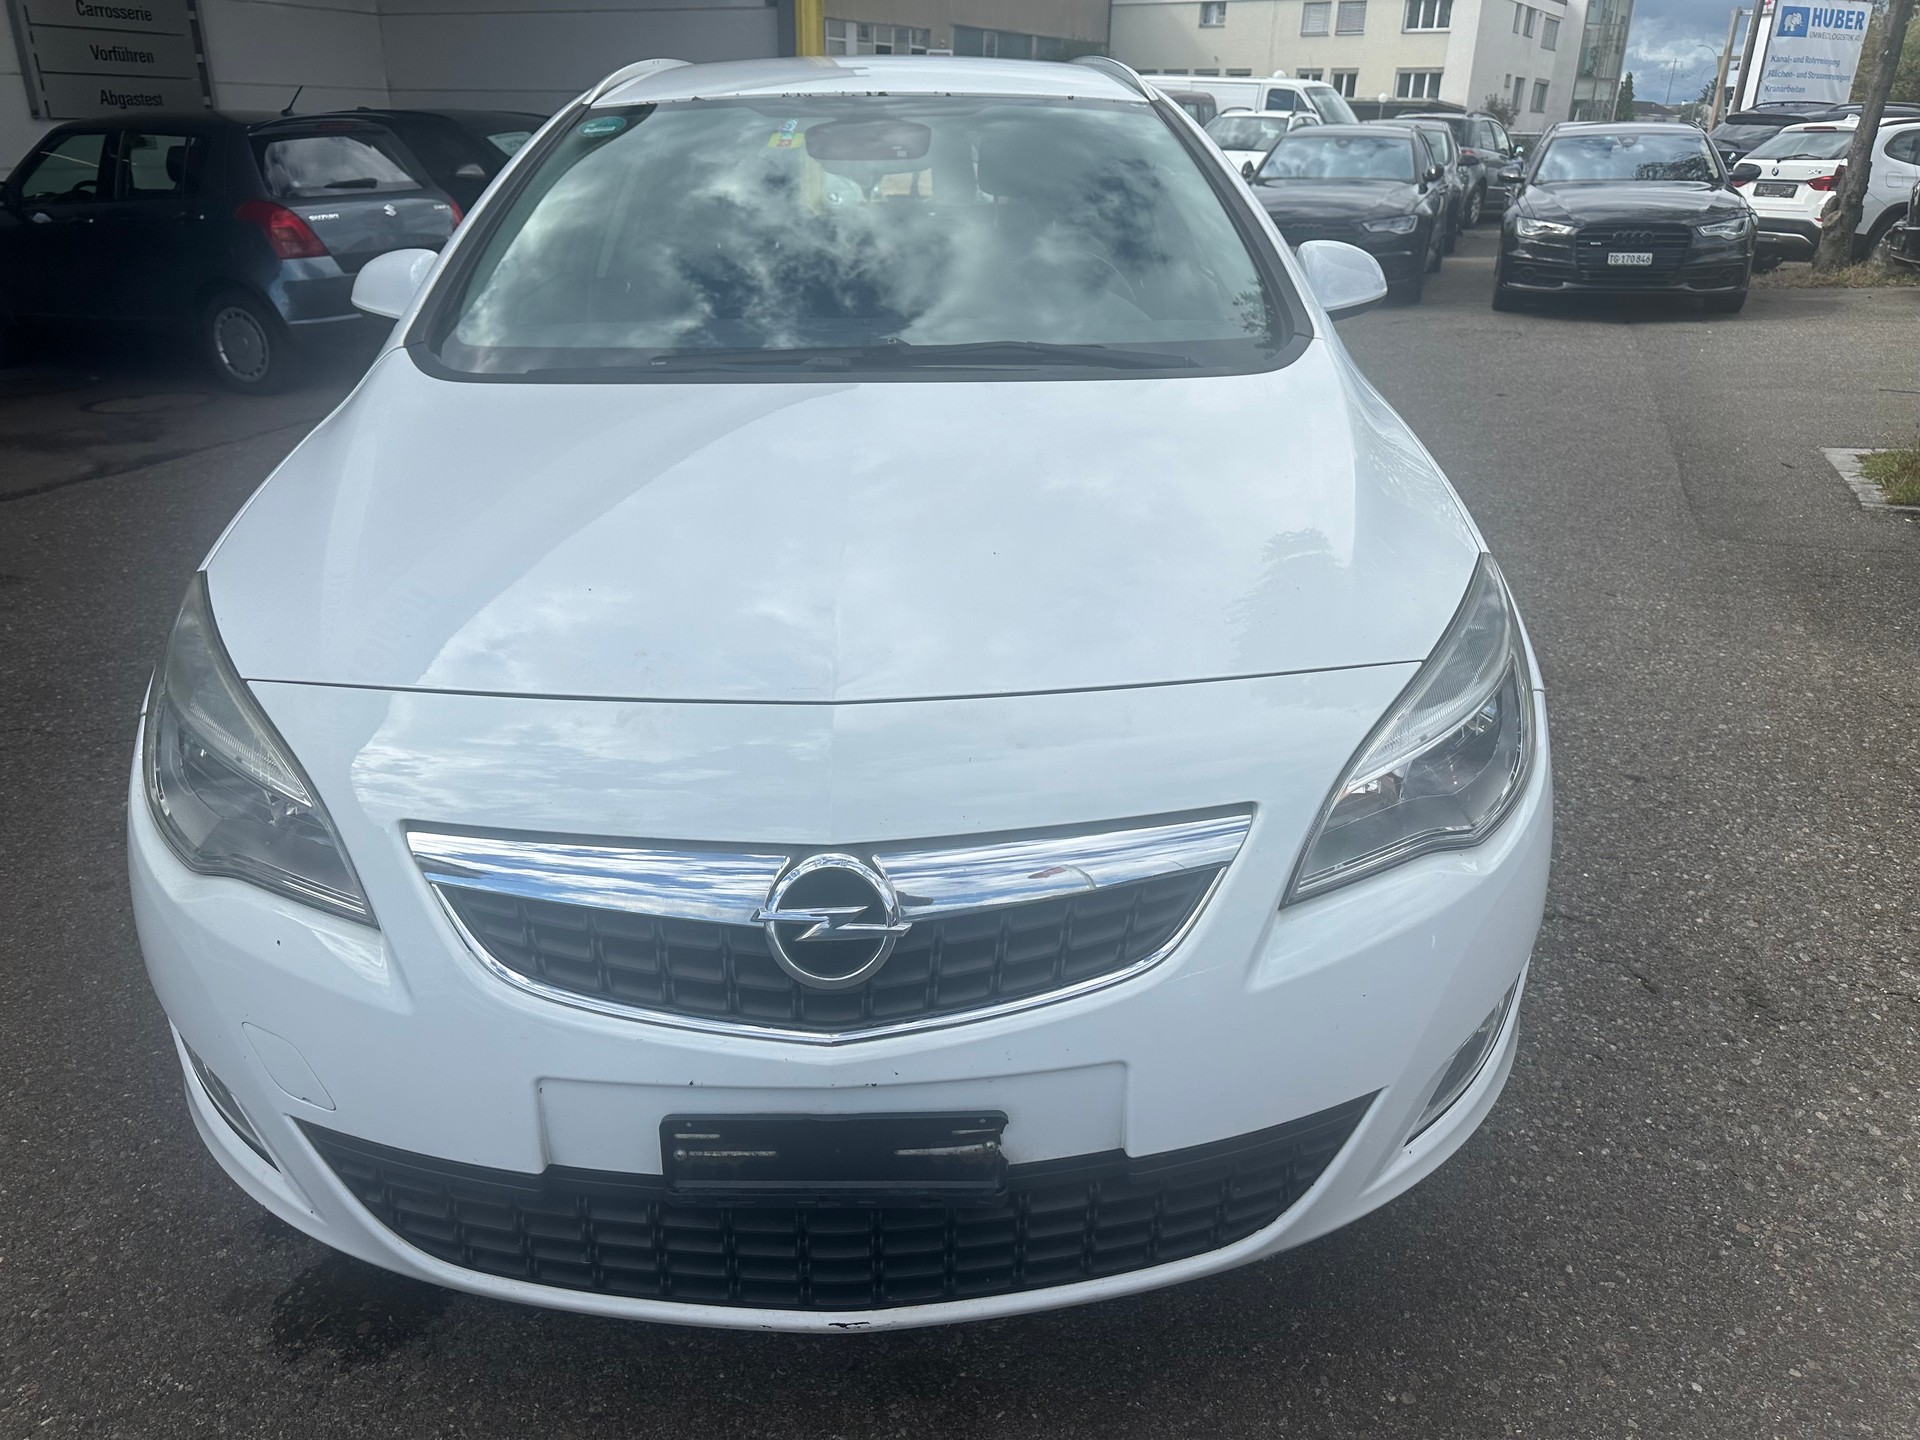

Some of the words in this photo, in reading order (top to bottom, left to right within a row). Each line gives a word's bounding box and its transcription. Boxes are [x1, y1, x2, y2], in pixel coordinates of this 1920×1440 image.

[75, 0, 153, 21] Carrosserie
[1811, 7, 1865, 31] HUBER
[89, 44, 154, 63] Vorführen
[1770, 54, 1793, 63] Kanal-
[1793, 56, 1804, 64] und
[1764, 84, 1806, 93] Kranarbeiten
[100, 89, 164, 109] Abgastest
[1609, 254, 1620, 264] TG
[1621, 254, 1651, 264] 170846
